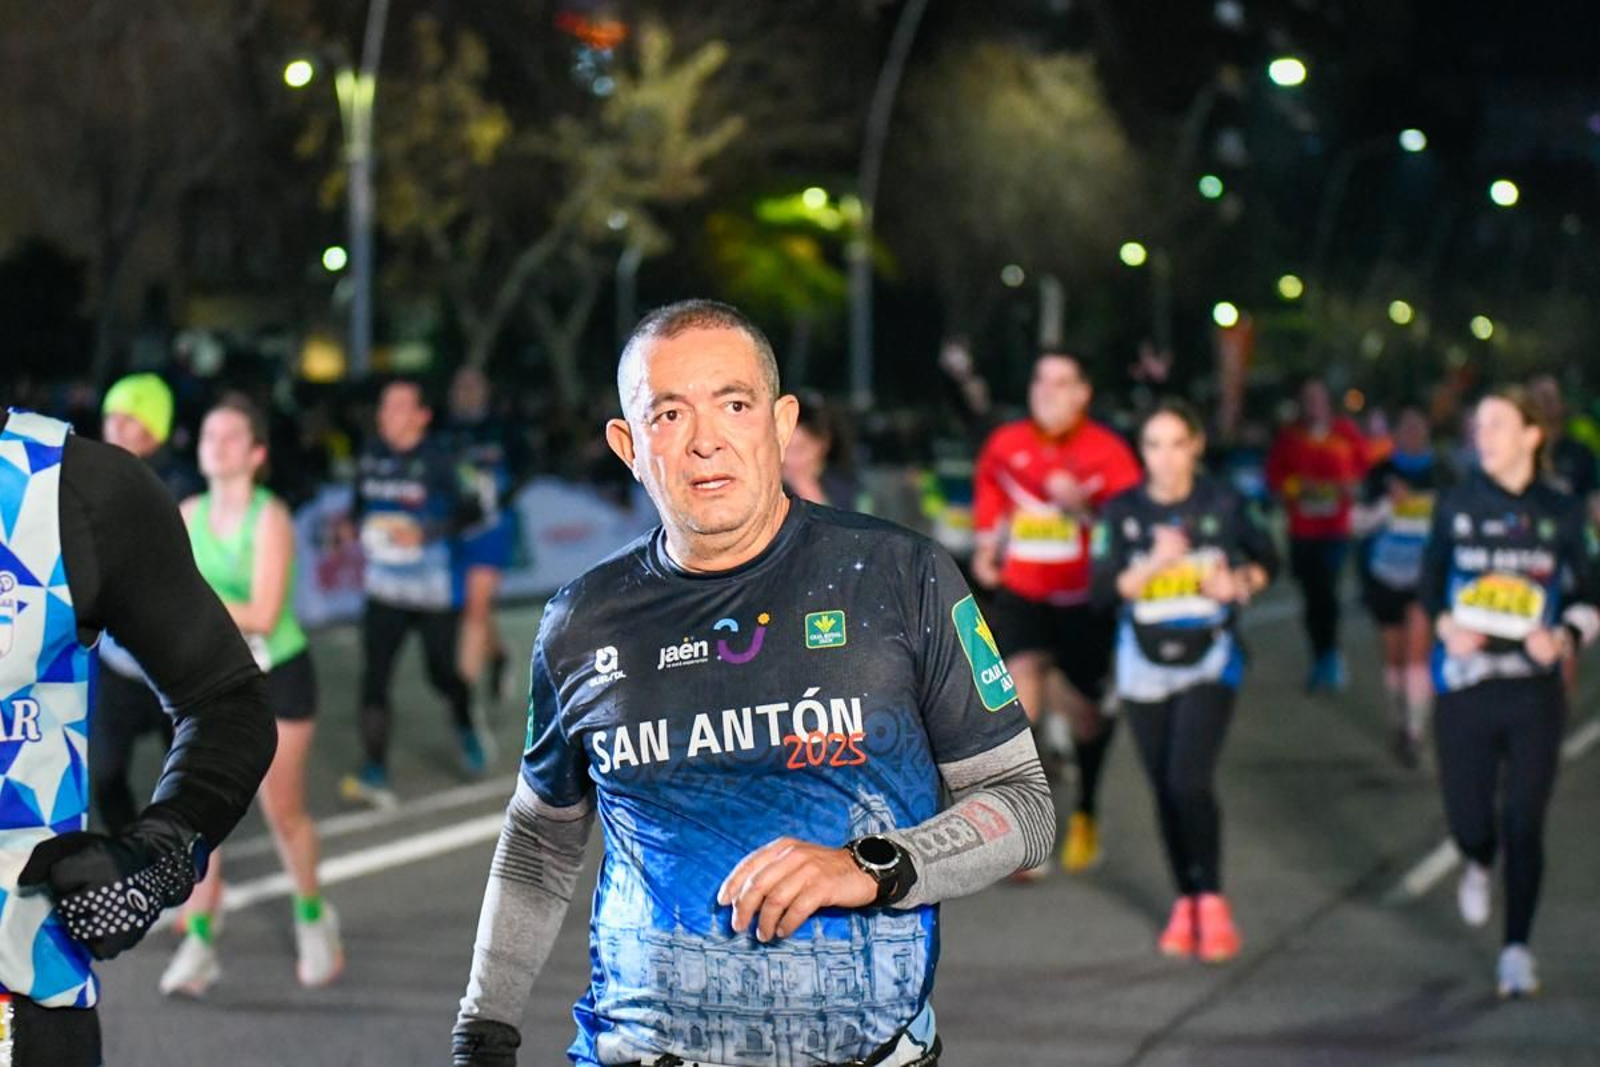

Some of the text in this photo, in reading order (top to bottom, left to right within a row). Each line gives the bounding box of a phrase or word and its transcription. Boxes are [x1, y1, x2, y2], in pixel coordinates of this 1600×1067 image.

[592, 687, 863, 774] SAN ANTÓN
[783, 730, 867, 769] 2025
